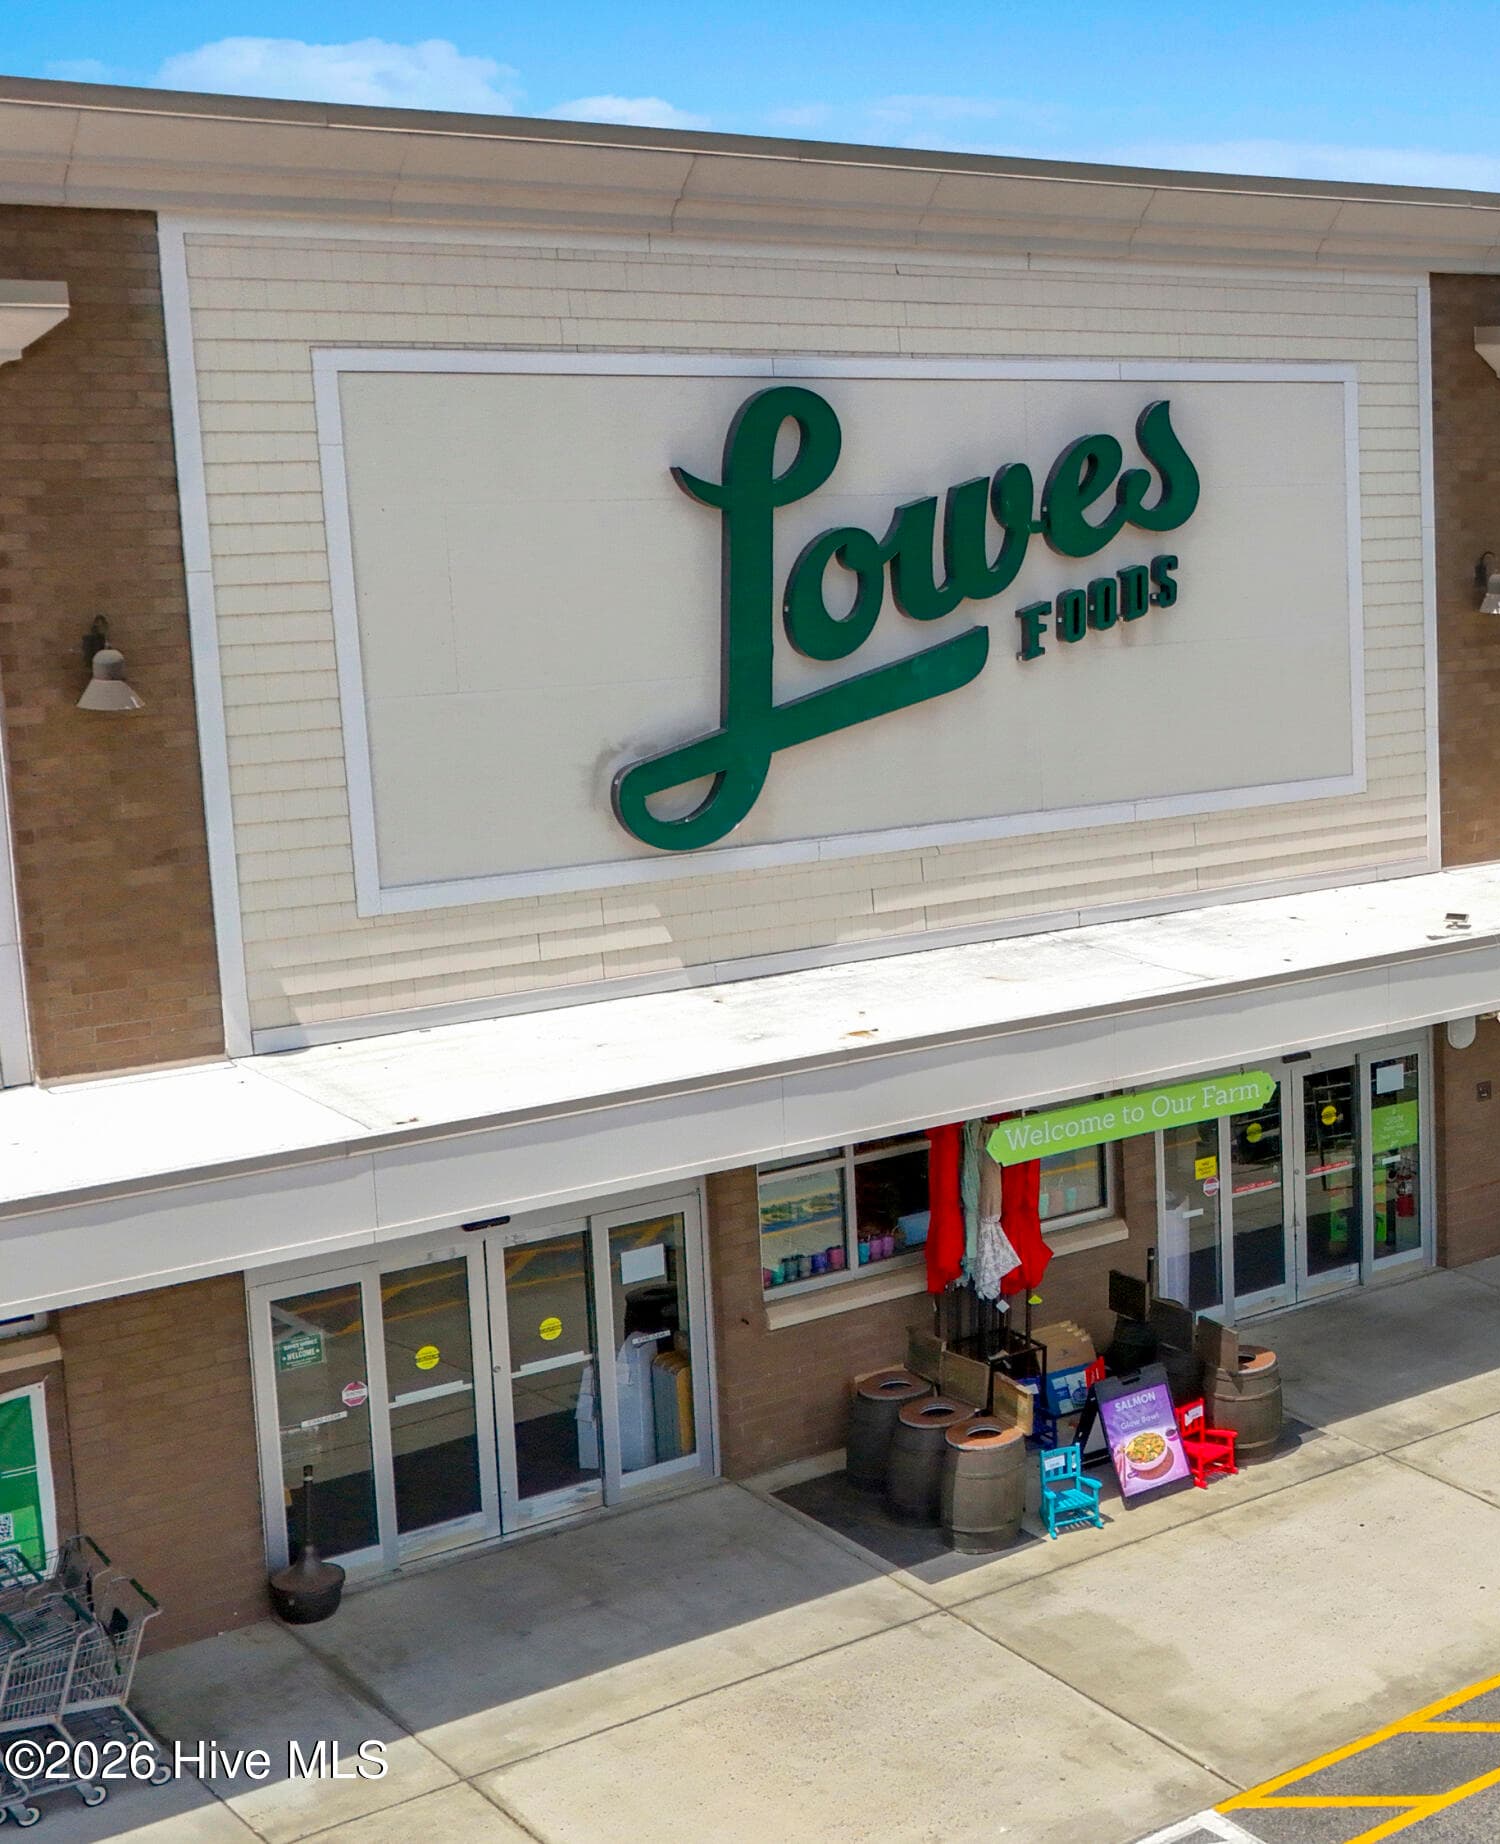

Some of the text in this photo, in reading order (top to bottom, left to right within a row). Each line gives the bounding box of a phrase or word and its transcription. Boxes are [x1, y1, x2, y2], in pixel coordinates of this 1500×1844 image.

[611, 386, 1200, 851] Lowes
[1015, 554, 1179, 662] FOODS
[1004, 1081, 1260, 1151] Welcome to Our Farm
[1114, 1391, 1156, 1412] SALMON
